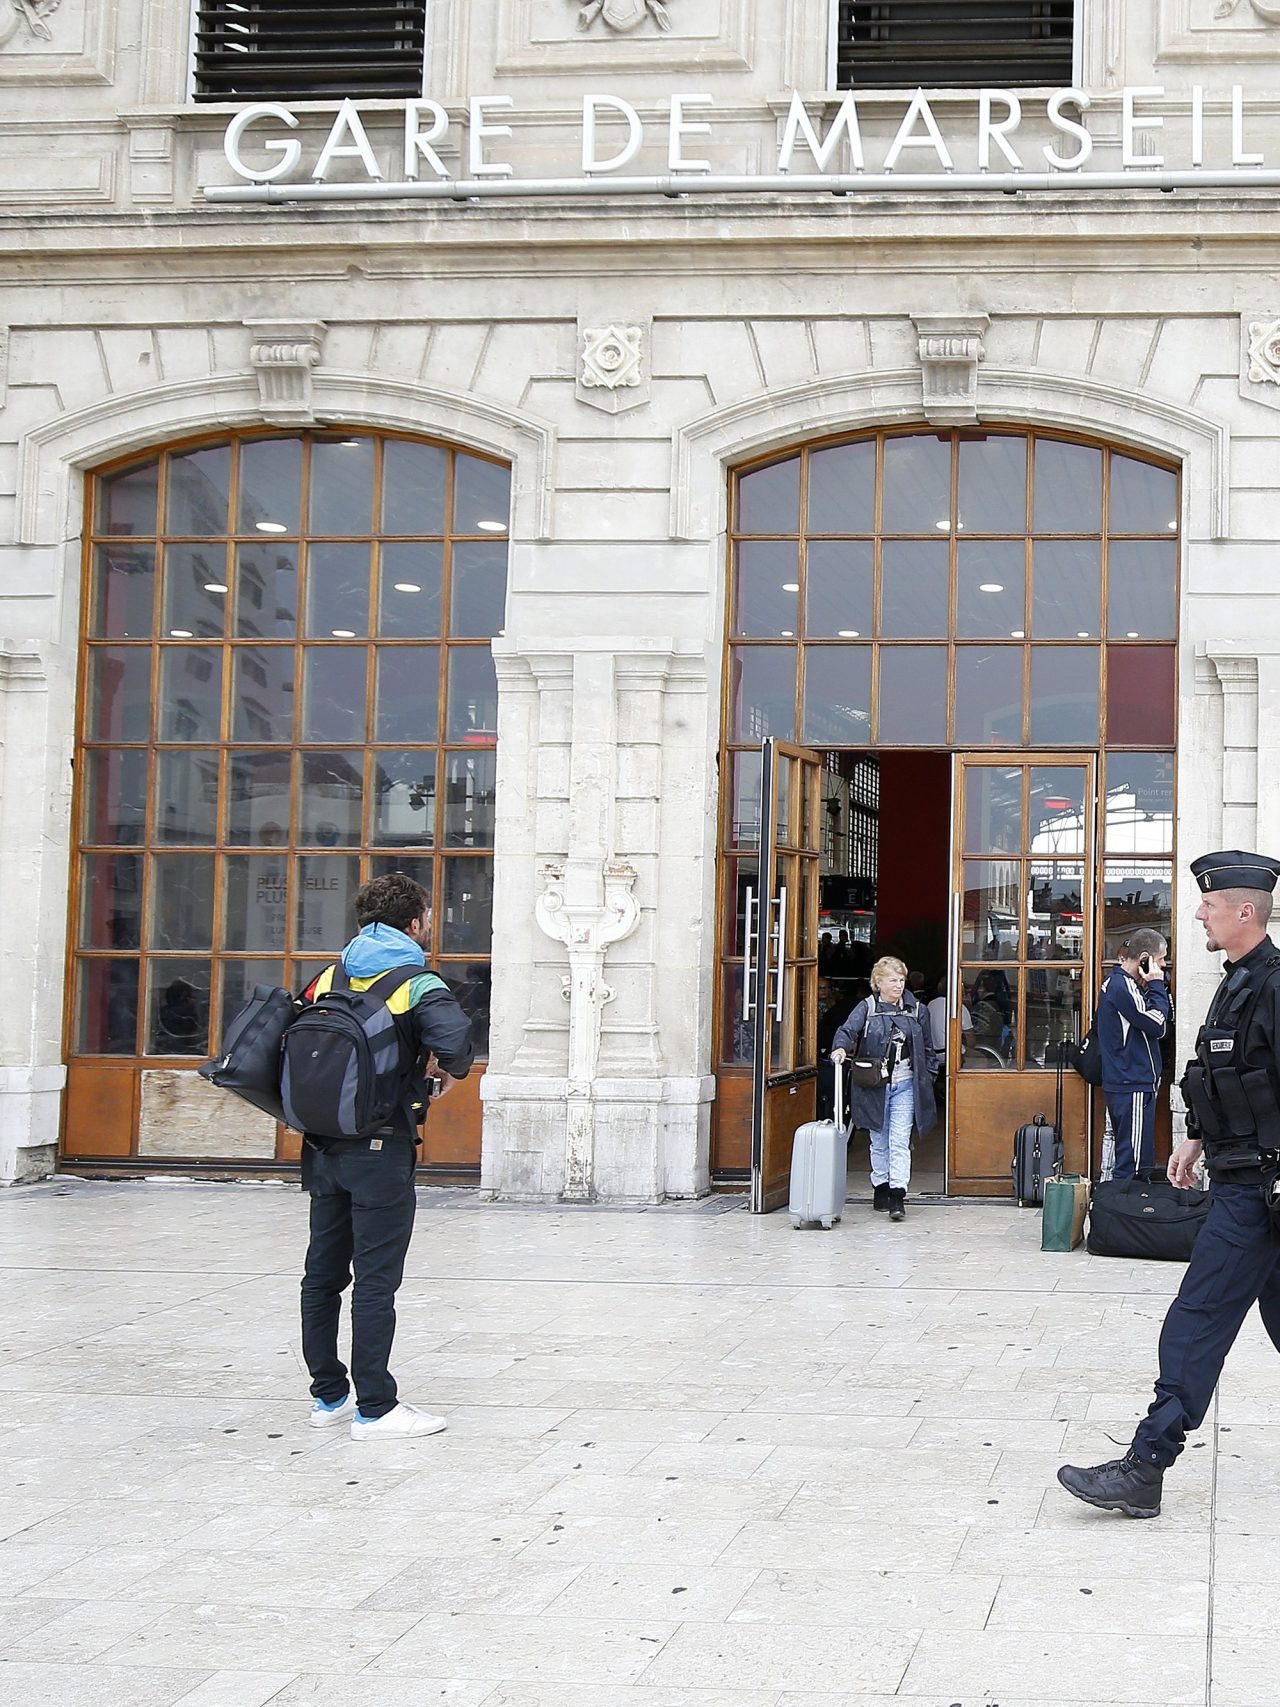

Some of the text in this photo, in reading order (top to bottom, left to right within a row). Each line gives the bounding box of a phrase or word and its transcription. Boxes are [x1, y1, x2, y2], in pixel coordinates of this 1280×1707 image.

[224, 94, 514, 181] GARE
[582, 92, 713, 174] DE
[305, 878, 339, 890] ELLE
